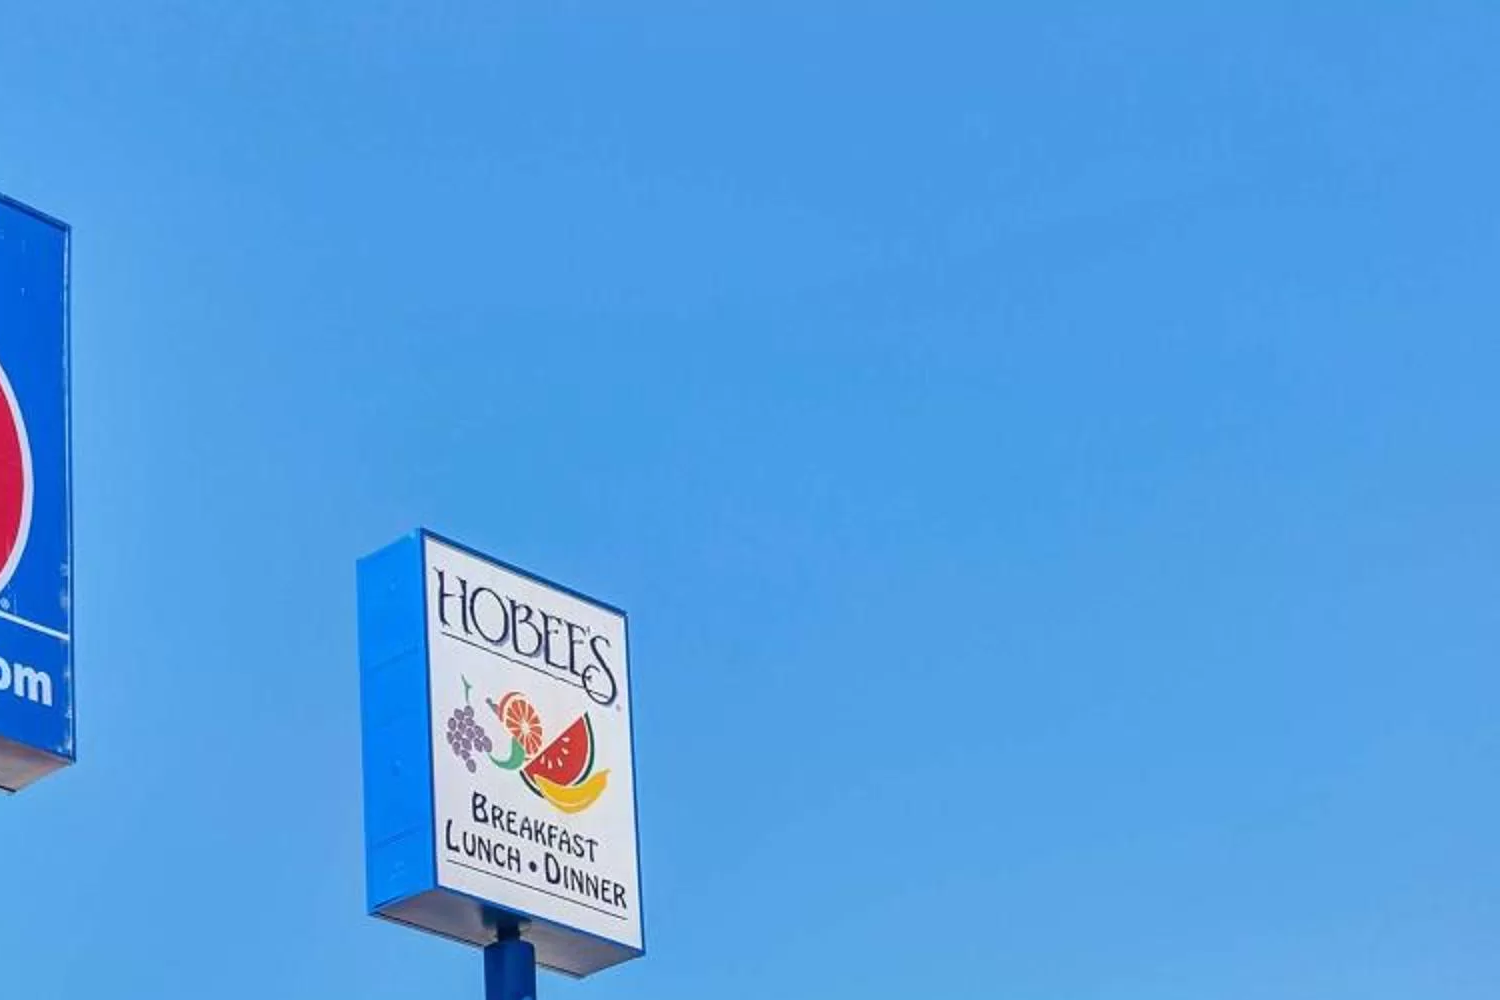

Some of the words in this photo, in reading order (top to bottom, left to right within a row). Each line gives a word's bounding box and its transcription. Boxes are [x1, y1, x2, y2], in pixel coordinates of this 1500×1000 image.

[432, 566, 617, 706] HOBEE'S
[446, 819, 521, 873] LUNCH
[544, 853, 627, 909] DINNER
[472, 791, 598, 862] BREAKFAST
